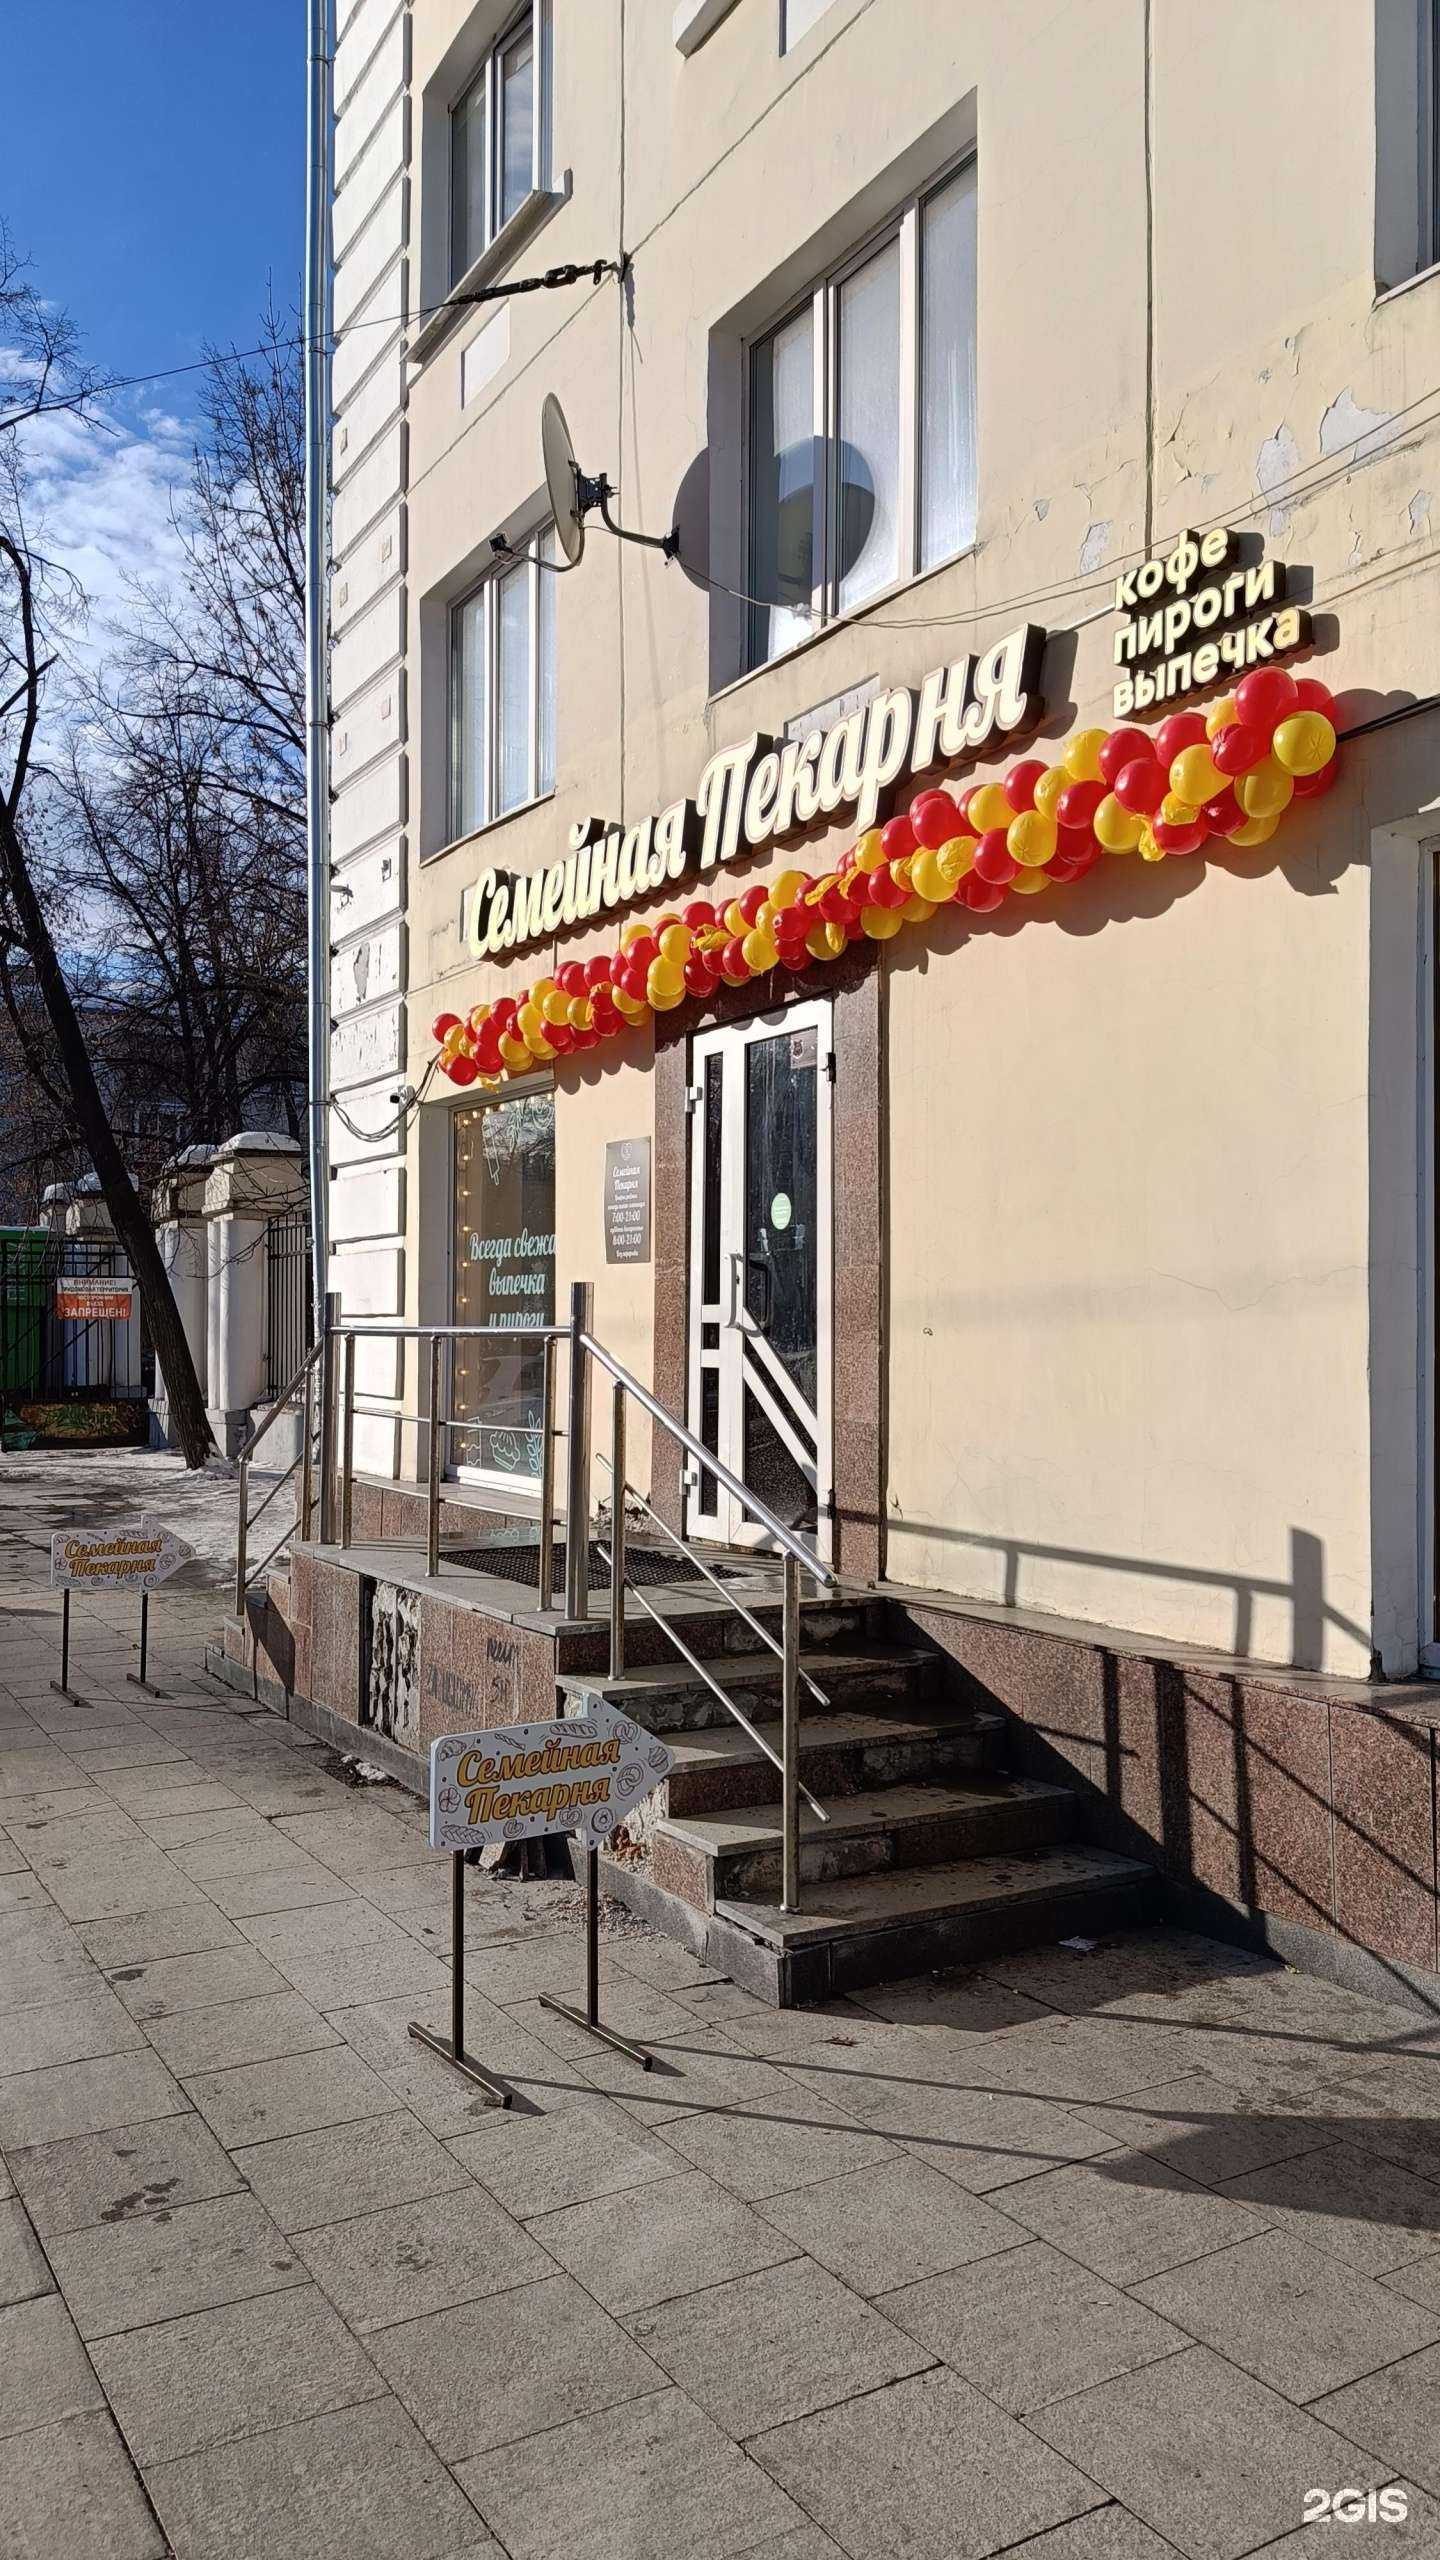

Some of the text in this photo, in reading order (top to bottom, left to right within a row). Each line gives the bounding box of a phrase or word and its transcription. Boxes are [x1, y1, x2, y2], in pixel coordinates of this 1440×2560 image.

[1115, 527, 1229, 611] кофе
[1114, 560, 1275, 665] пироги
[1113, 607, 1300, 719] выпечка
[468, 623, 1029, 960] Семейная Пекарня
[470, 1228, 556, 1267] Всегда свежа
[488, 1267, 546, 1296] выпечка
[64, 1537, 163, 1559] Семейная
[69, 1558, 157, 1579] Пекарня
[457, 1738, 621, 1788] Семейная
[464, 1777, 611, 1825] Пекарня
